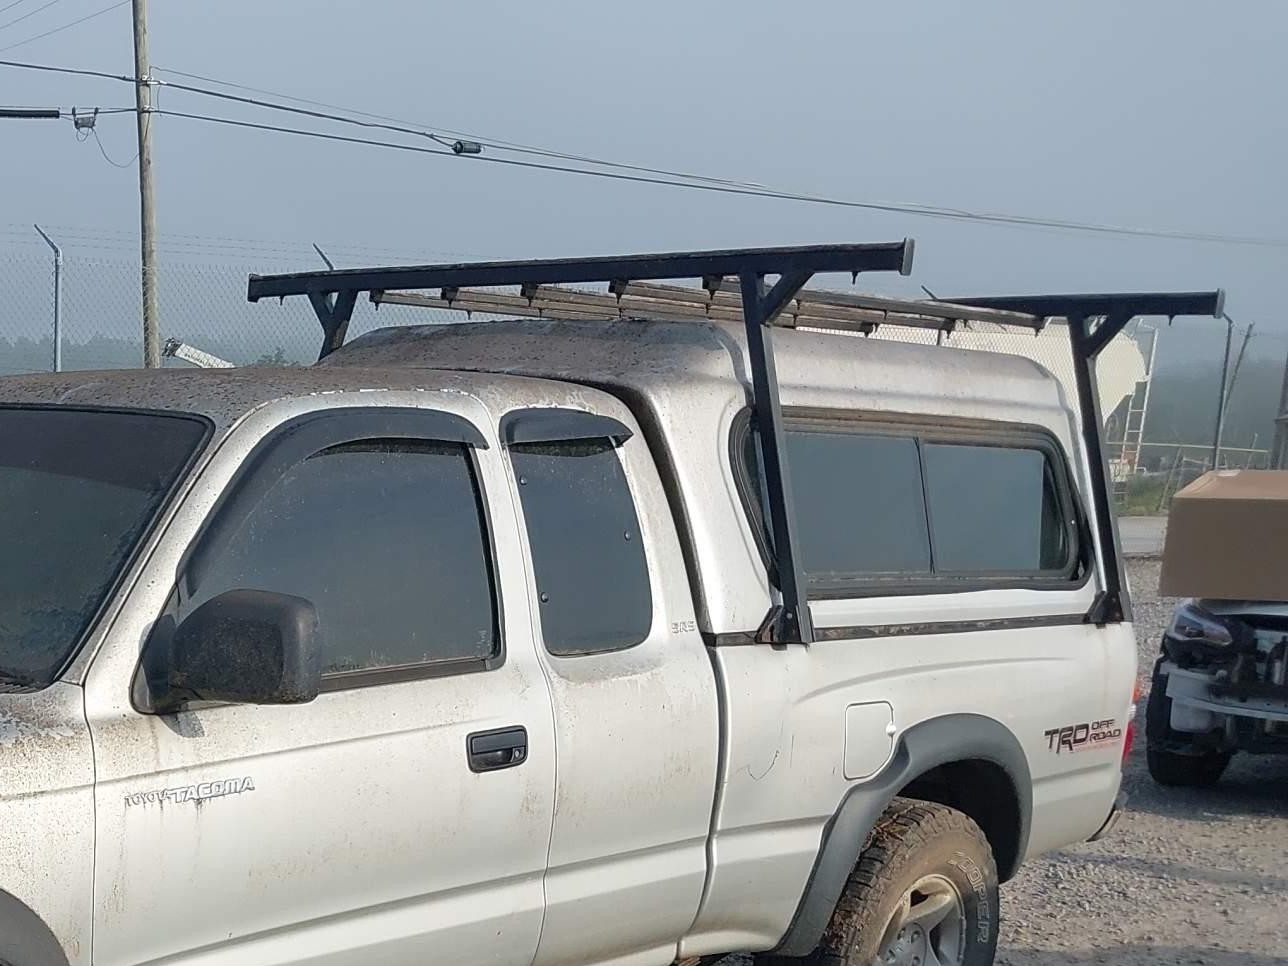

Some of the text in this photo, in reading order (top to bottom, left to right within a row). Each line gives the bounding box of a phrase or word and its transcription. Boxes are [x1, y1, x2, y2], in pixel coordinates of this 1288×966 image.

[1091, 719, 1116, 730] OFF
[1044, 723, 1090, 754] TRD
[1090, 728, 1122, 742] ROAD
[171, 776, 256, 803] TACOMA
